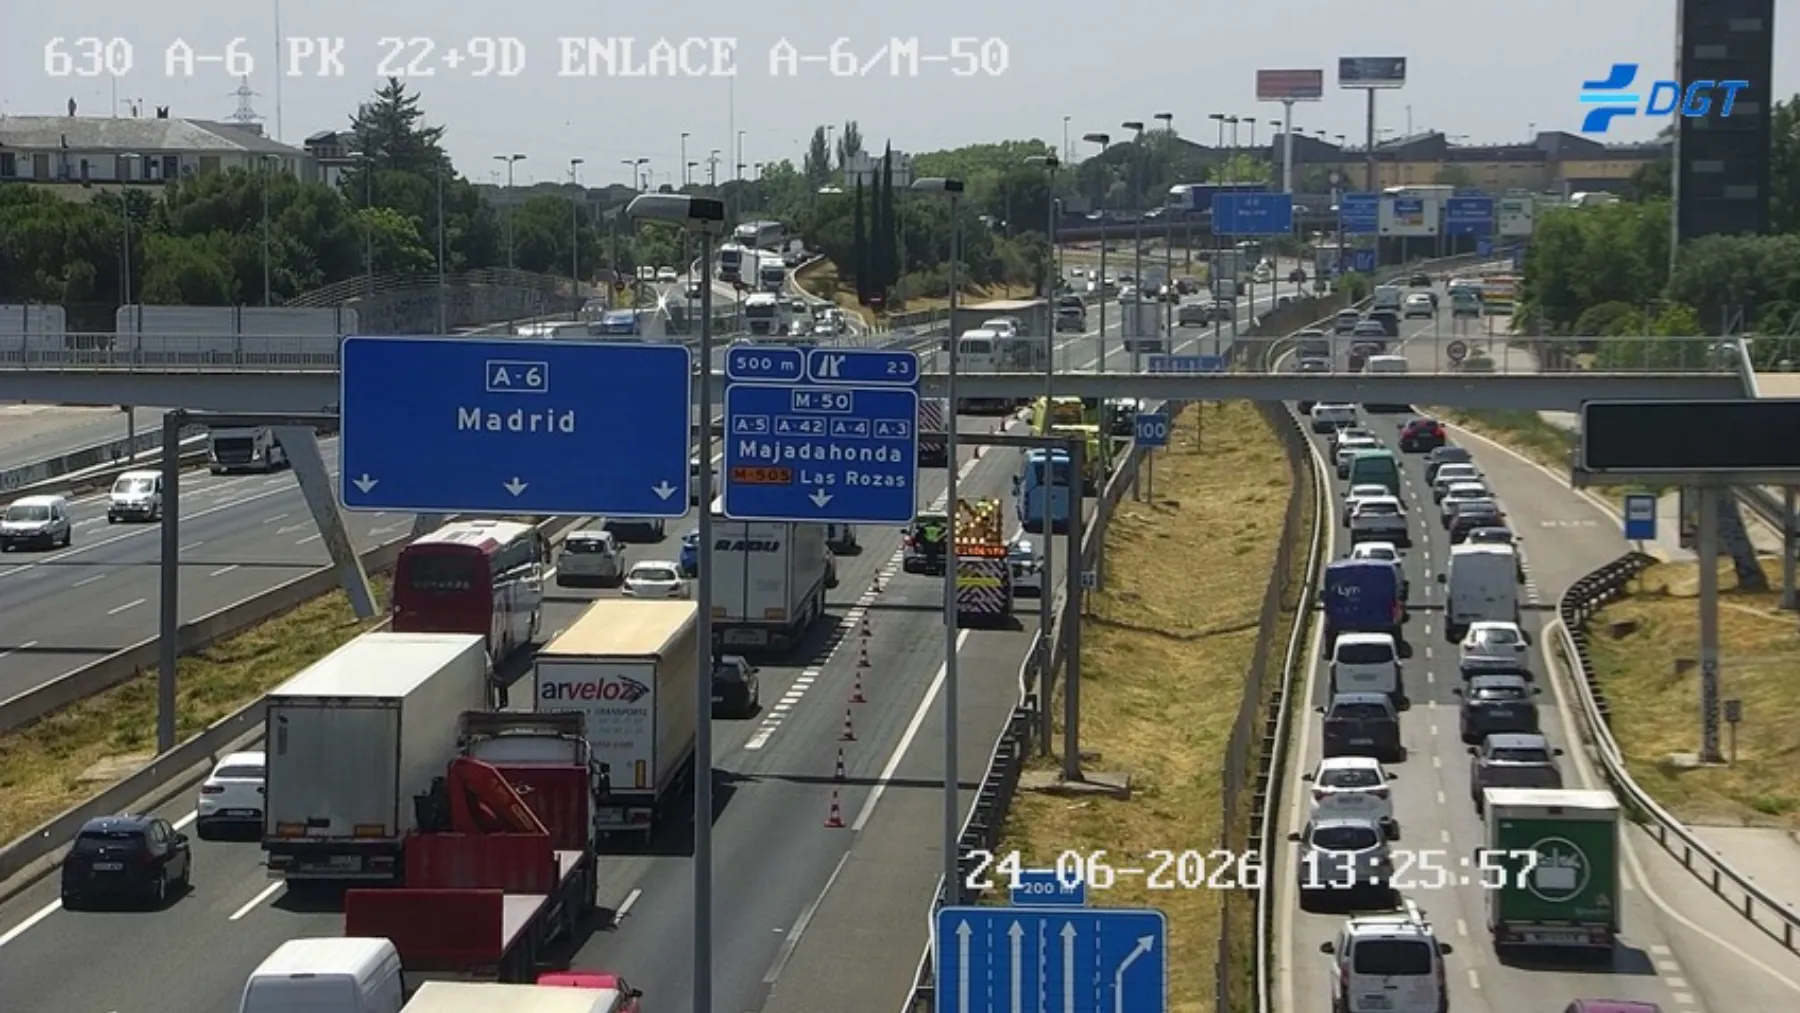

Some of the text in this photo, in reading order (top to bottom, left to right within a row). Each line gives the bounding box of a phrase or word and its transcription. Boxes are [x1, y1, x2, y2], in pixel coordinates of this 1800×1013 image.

[736, 357, 795, 370] 500 m
[887, 361, 909, 374] 23
[492, 367, 542, 387] A-6
[795, 393, 849, 410] M-50
[458, 407, 574, 431] Madrid
[736, 419, 907, 434] A-5 A-42 A-4 A-3
[1138, 421, 1165, 439] 100
[739, 440, 902, 464] Majadahonda
[734, 468, 906, 488] M-505 Las Rozas
[1023, 882, 1054, 894] 200
